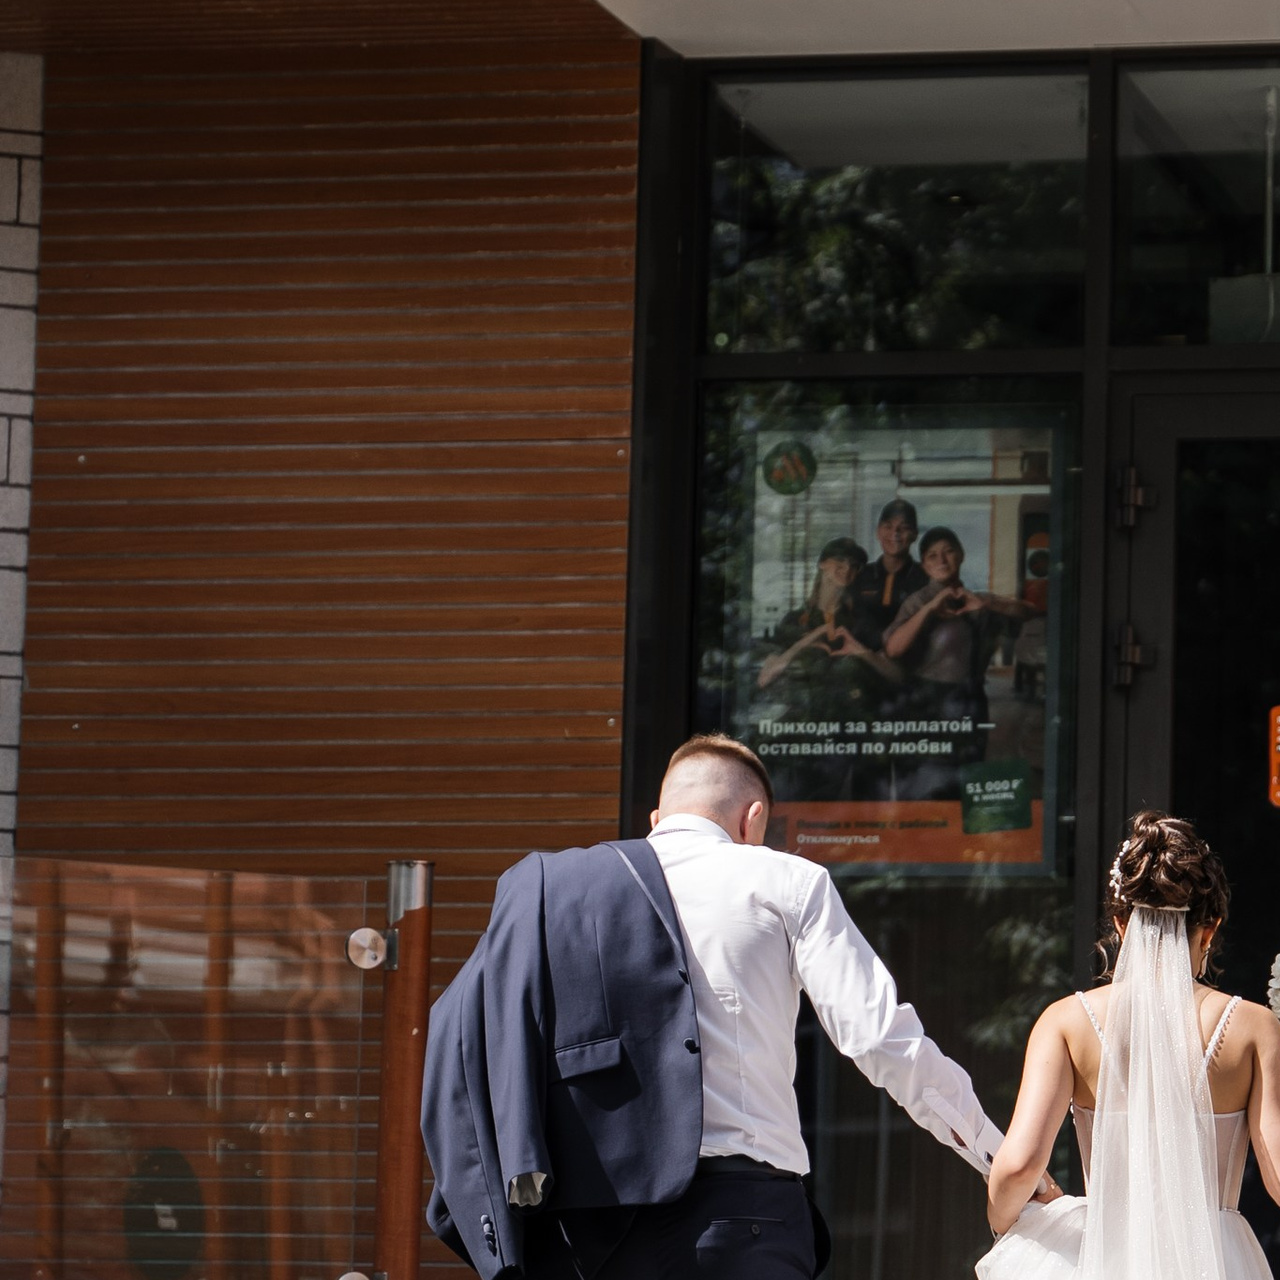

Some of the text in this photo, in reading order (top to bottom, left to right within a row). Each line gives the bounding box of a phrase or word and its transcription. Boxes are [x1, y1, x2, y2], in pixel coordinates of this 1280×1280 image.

[758, 720, 840, 736] Приходи
[844, 722, 867, 733] за
[871, 717, 973, 736] зарплатой
[758, 738, 953, 755] оставайся по любви
